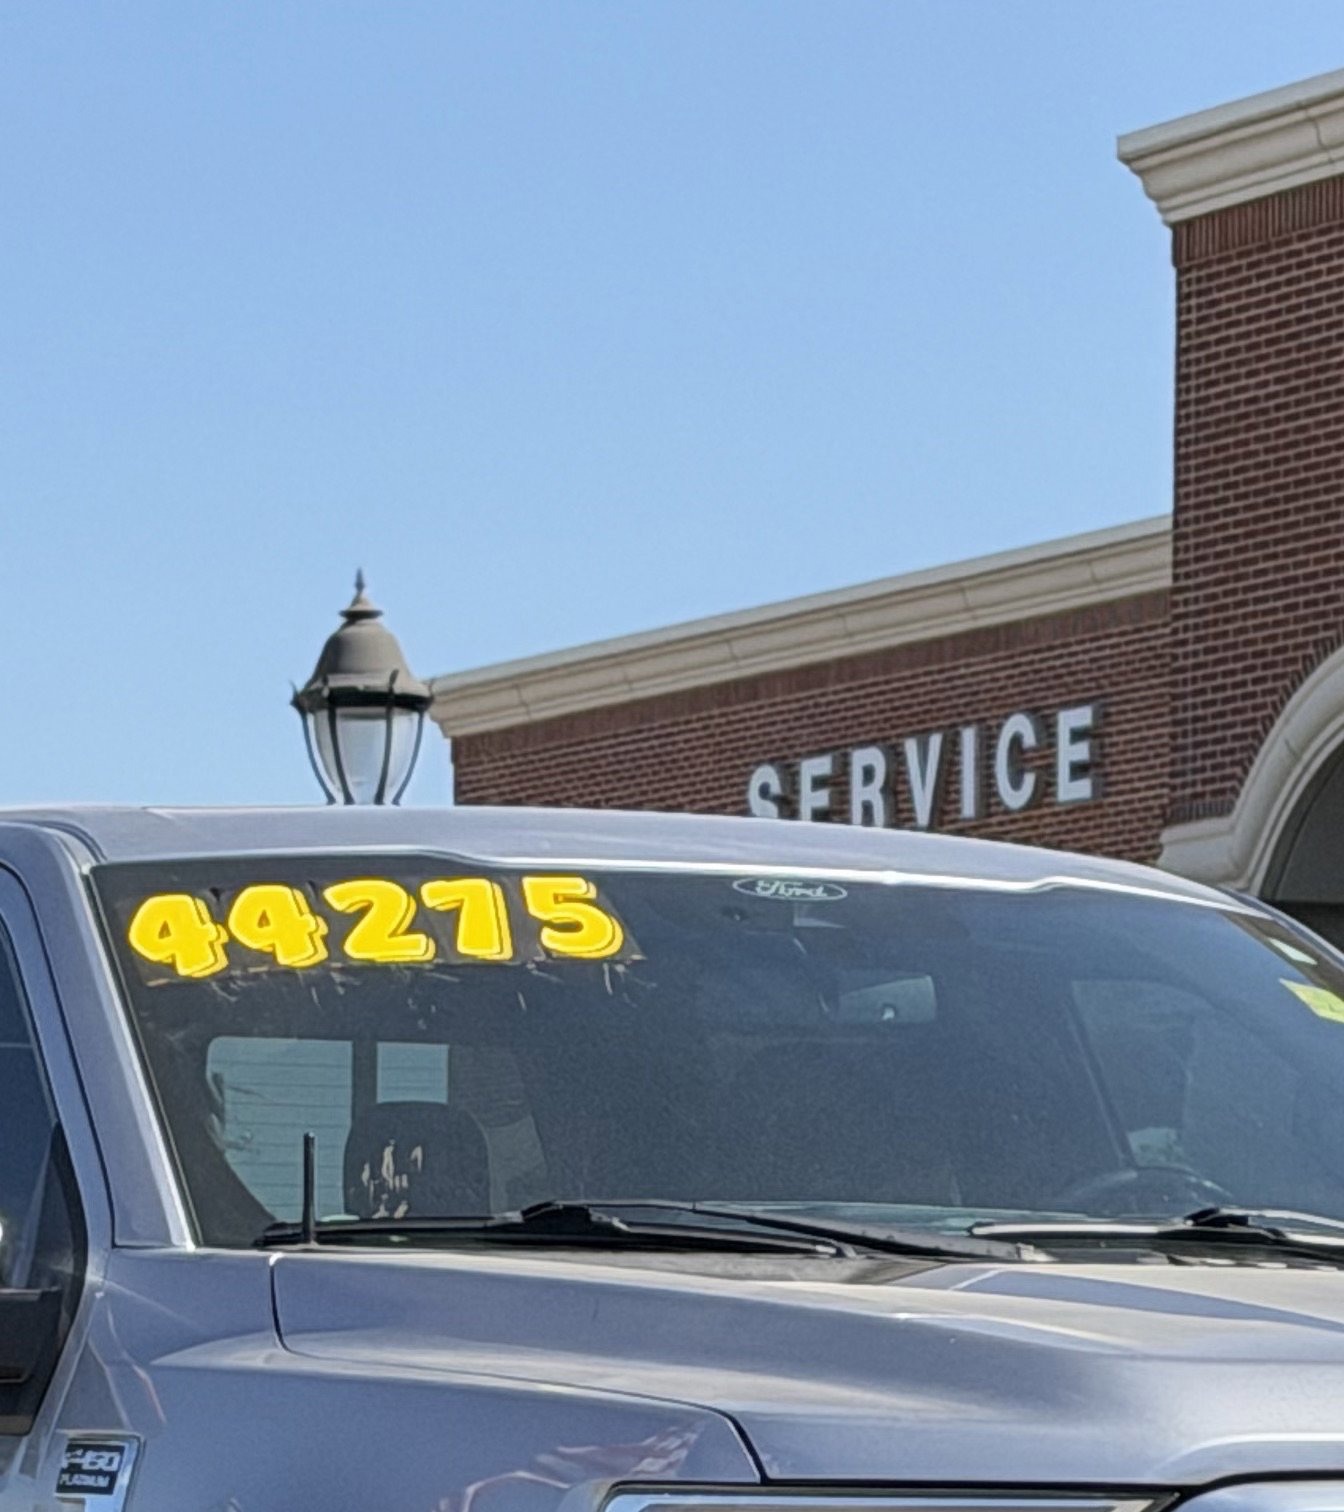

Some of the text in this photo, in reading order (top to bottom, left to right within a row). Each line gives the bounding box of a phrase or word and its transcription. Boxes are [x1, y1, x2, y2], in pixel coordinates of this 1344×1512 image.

[747, 704, 1098, 828] SERVICE
[128, 875, 624, 979] 44275
[754, 879, 828, 897] Ford
